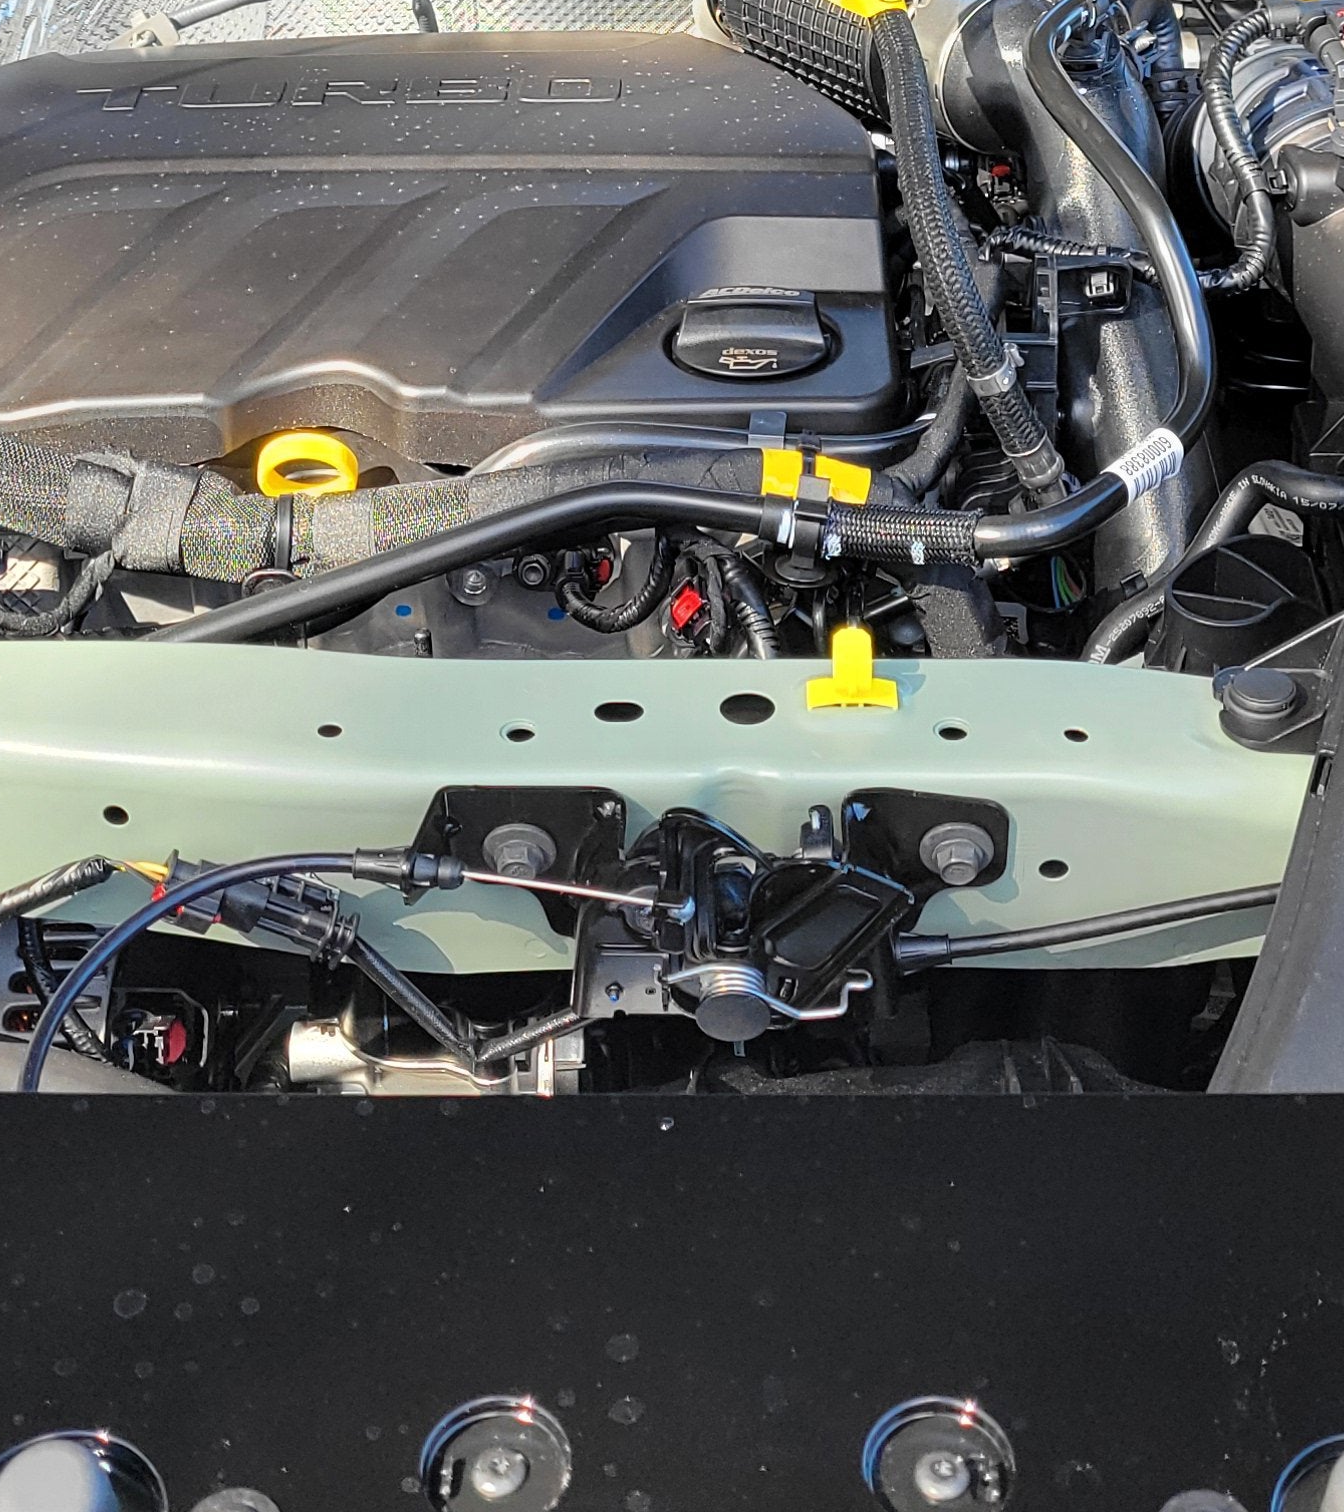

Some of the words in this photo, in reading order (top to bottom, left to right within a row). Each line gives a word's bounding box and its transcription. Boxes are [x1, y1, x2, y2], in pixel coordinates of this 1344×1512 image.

[76, 77, 623, 111] TURBO
[722, 347, 778, 356] dexos
[1119, 436, 1172, 476] 60008388
